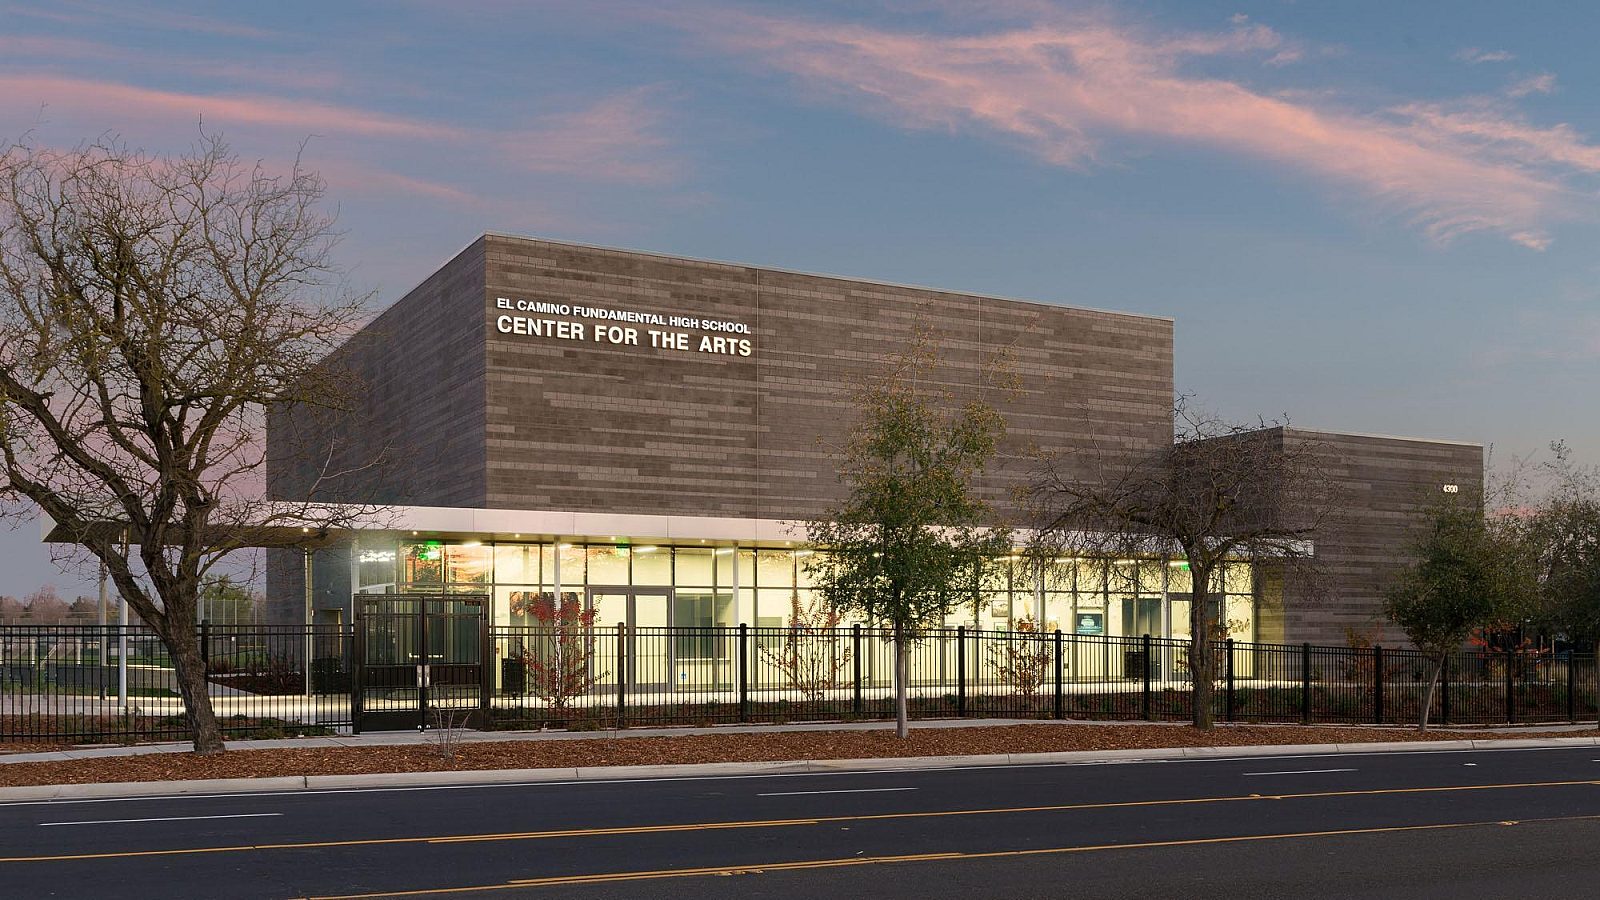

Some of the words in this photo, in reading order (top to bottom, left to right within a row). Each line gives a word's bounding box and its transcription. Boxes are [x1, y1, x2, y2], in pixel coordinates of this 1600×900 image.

[497, 297, 515, 310] EL
[517, 299, 570, 316] CAMINO
[573, 305, 667, 327] FUNDAMENTAL
[669, 316, 699, 329] HIGH
[701, 319, 752, 335] SCHOOL
[497, 314, 585, 341] CENTER
[594, 325, 638, 346] FOR
[648, 330, 689, 351] THE
[698, 335, 752, 357] ARTS
